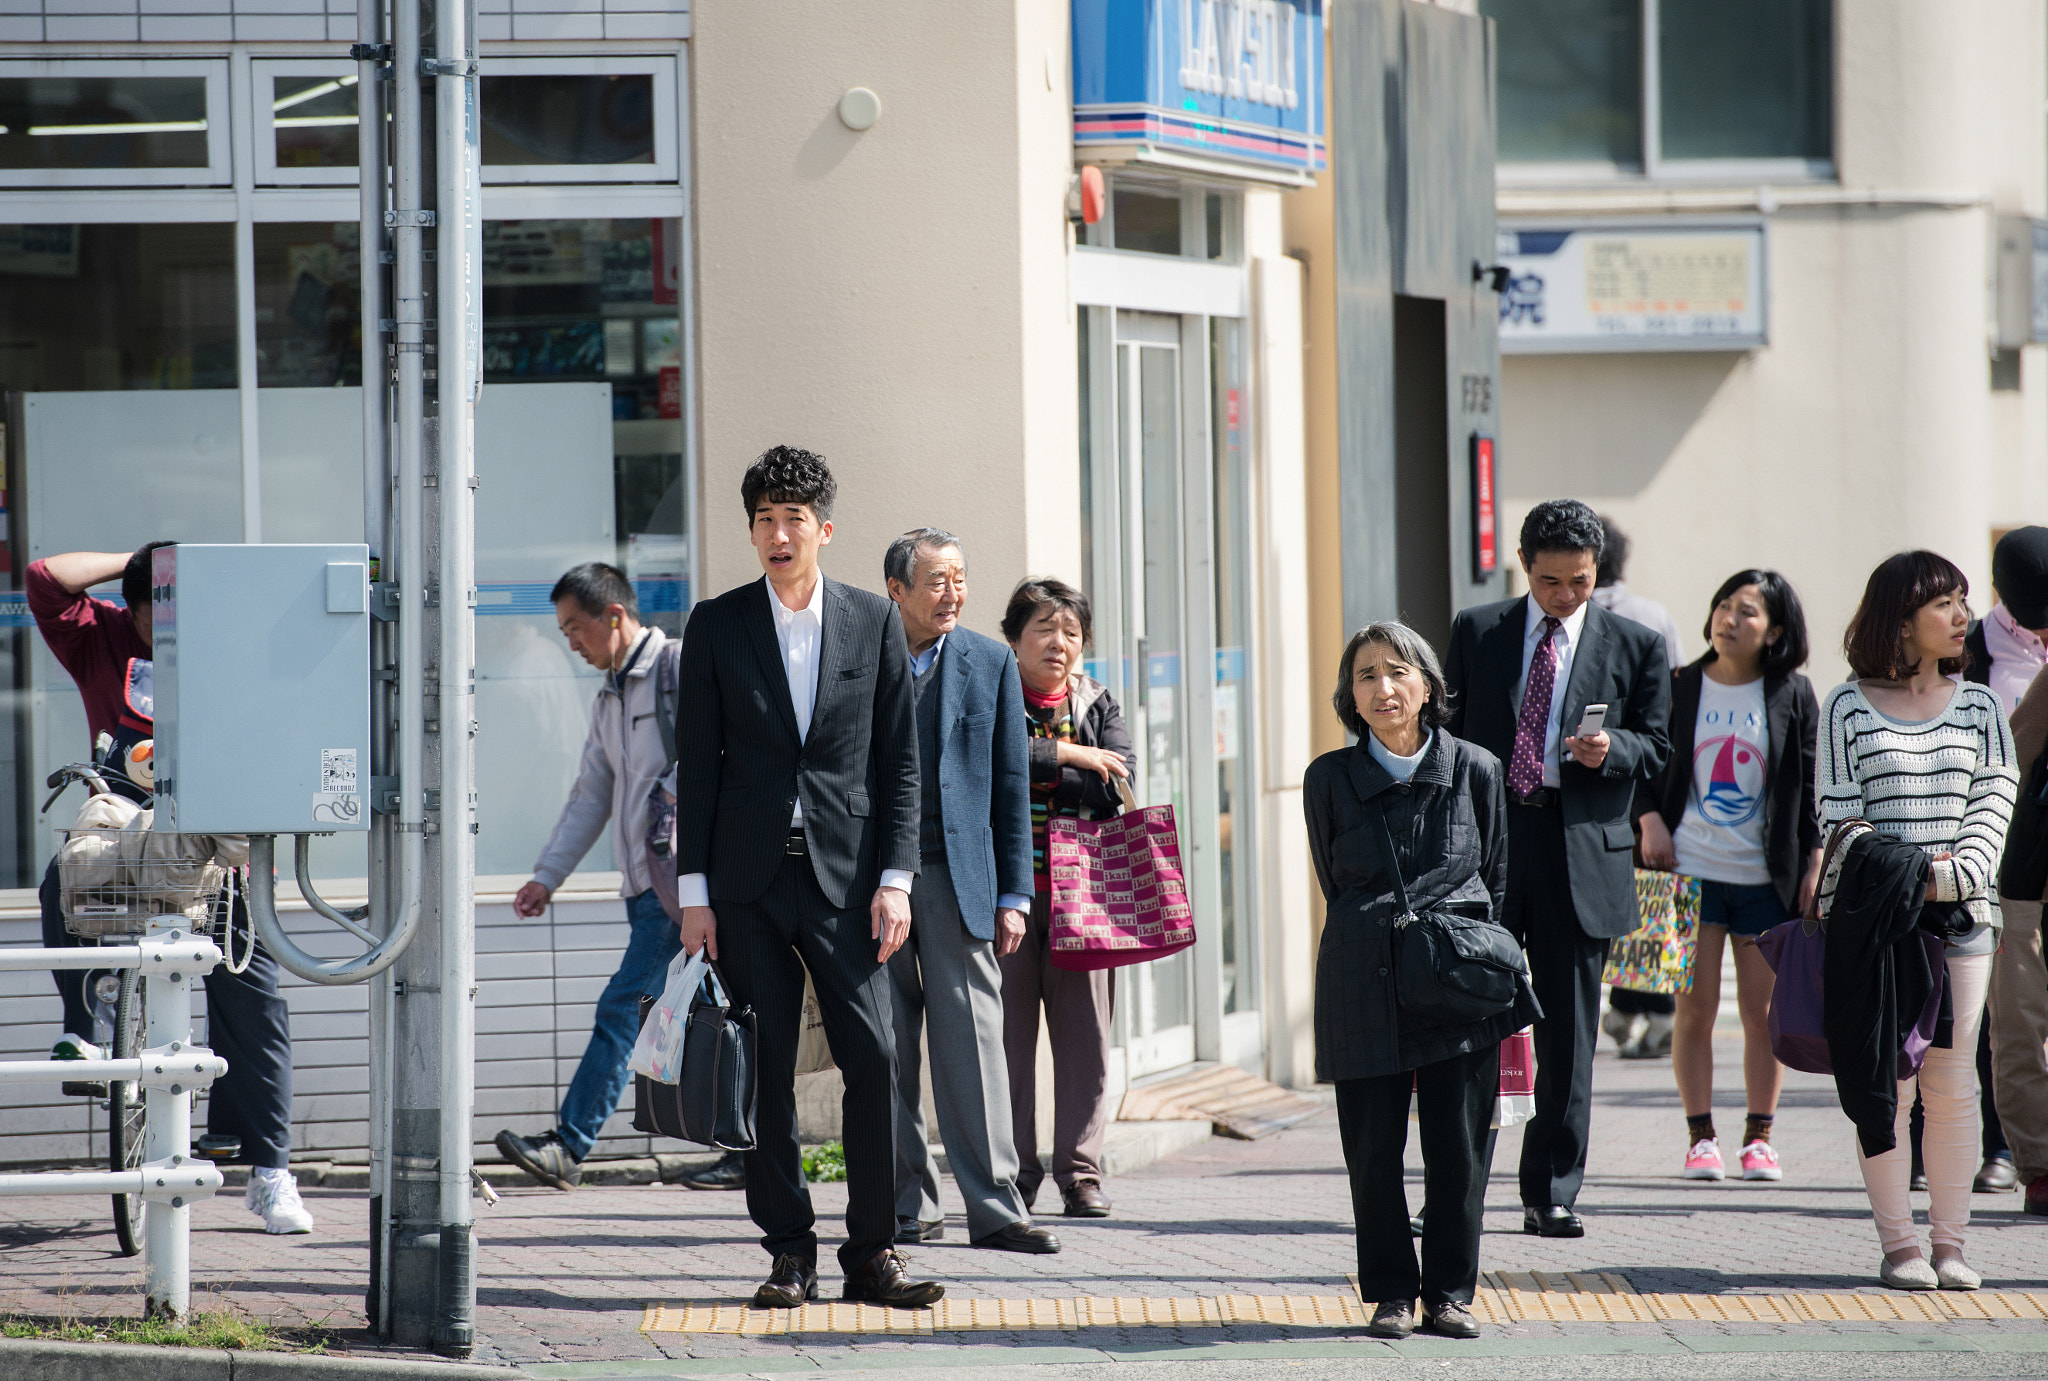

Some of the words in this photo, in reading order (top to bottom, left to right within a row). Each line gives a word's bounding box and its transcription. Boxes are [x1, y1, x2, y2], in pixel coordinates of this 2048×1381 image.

[1706, 710, 1769, 729] OIA
[1145, 808, 1171, 822] ikari
[1052, 821, 1076, 831] ikari
[1100, 820, 1124, 834] ikari
[1126, 825, 1146, 841] ikari
[1078, 834, 1100, 845] ikari
[1149, 833, 1175, 845] ikari
[1054, 845, 1078, 854] ikari
[1102, 845, 1127, 858] ikari
[1081, 857, 1102, 868] ikari
[1130, 849, 1151, 866] ikari
[1153, 857, 1179, 870] ikari
[1054, 868, 1080, 878] ikari
[1104, 869, 1131, 880] ikari
[1082, 880, 1104, 891] ikari
[1133, 872, 1155, 889] ikari
[1157, 882, 1183, 894] ikari
[1054, 892, 1080, 902] ikari
[1107, 892, 1134, 902] ikari
[1082, 903, 1107, 914] ikari
[1136, 897, 1159, 912] ikari
[1162, 905, 1188, 918] ikari
[1056, 915, 1081, 926] ikari
[1110, 914, 1137, 925] ikari
[1084, 926, 1109, 936] ikari
[1139, 922, 1163, 935] ikari
[1166, 929, 1192, 942] ikari
[1057, 939, 1083, 949] ikari
[1113, 937, 1138, 947] ikari
[1625, 940, 1663, 968] APR
